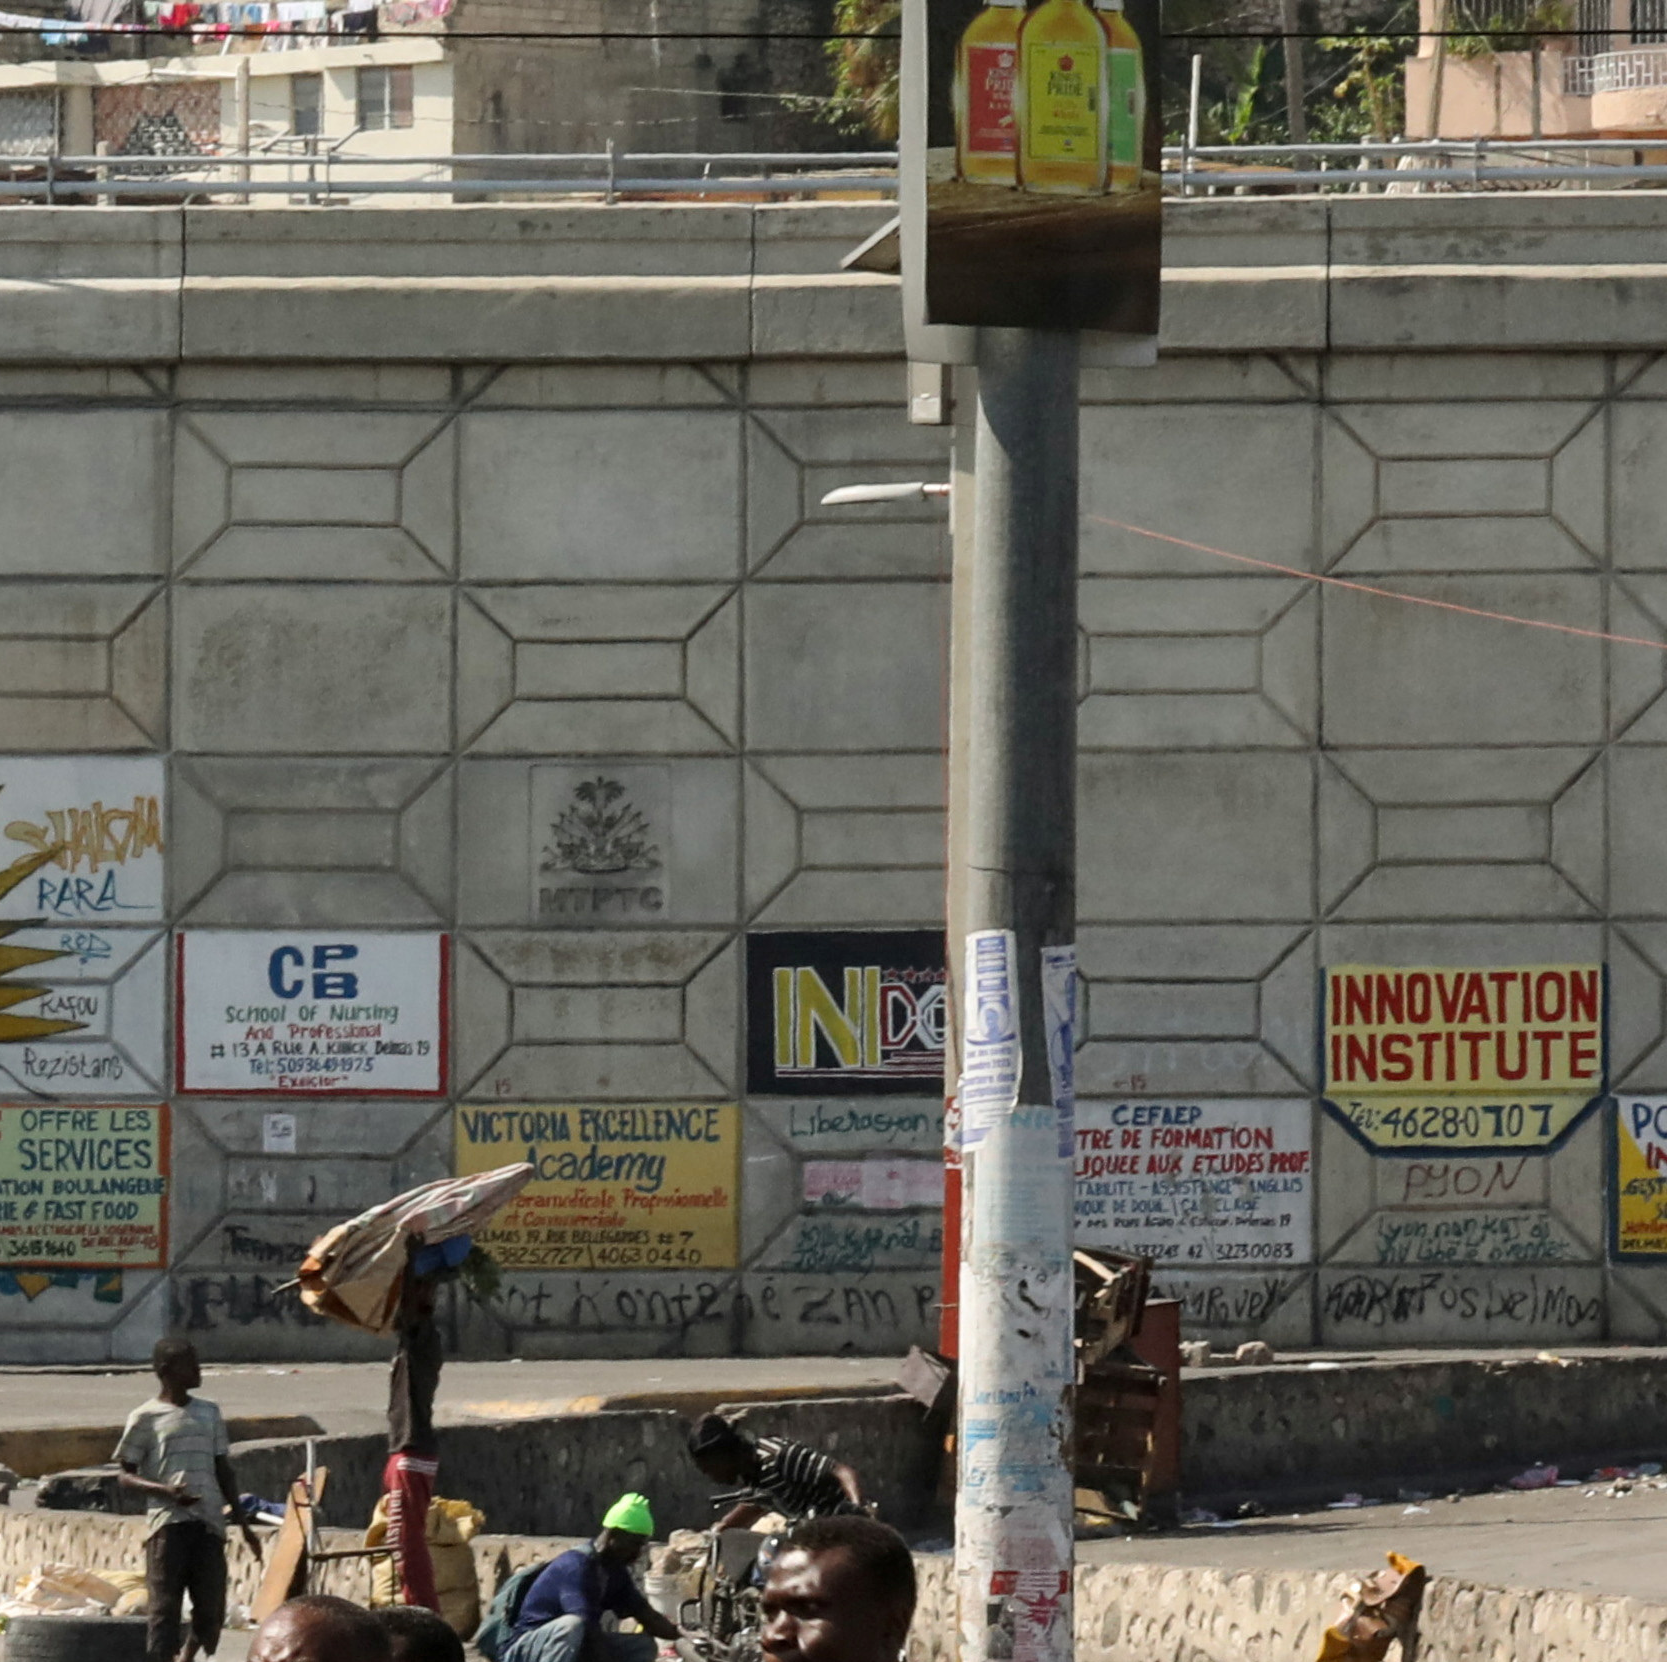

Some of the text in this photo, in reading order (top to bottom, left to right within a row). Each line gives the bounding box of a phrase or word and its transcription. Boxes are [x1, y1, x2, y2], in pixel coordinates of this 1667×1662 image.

[37, 868, 155, 917] RARA
[539, 886, 665, 913] MTPTC
[1331, 969, 1599, 1027] INNOVATION
[225, 1004, 287, 1024] School
[329, 1003, 400, 1024] Nursing
[244, 1023, 383, 1040] And Professional
[1331, 1030, 1600, 1083] INSTITUTE
[20, 1109, 99, 1132] OFFRE
[109, 1109, 153, 1132] LES
[461, 1110, 571, 1143] VICTORIA
[1632, 1102, 1667, 1141] PO
[1075, 1126, 1275, 1150] TRE DE FORMATION
[18, 1137, 153, 1172] SERVICES
[1074, 1154, 1140, 1178] LIQUEE
[1145, 1153, 1182, 1174] AUX
[1192, 1152, 1265, 1178] ETUDES
[1646, 1141, 1667, 1171] IN
[525, 1145, 668, 1194] Academy
[1075, 1180, 1136, 1197] TABILITE
[44, 1200, 85, 1221] FAST
[91, 1200, 140, 1221] FOOD
[474, 1230, 519, 1242] ELMAS
